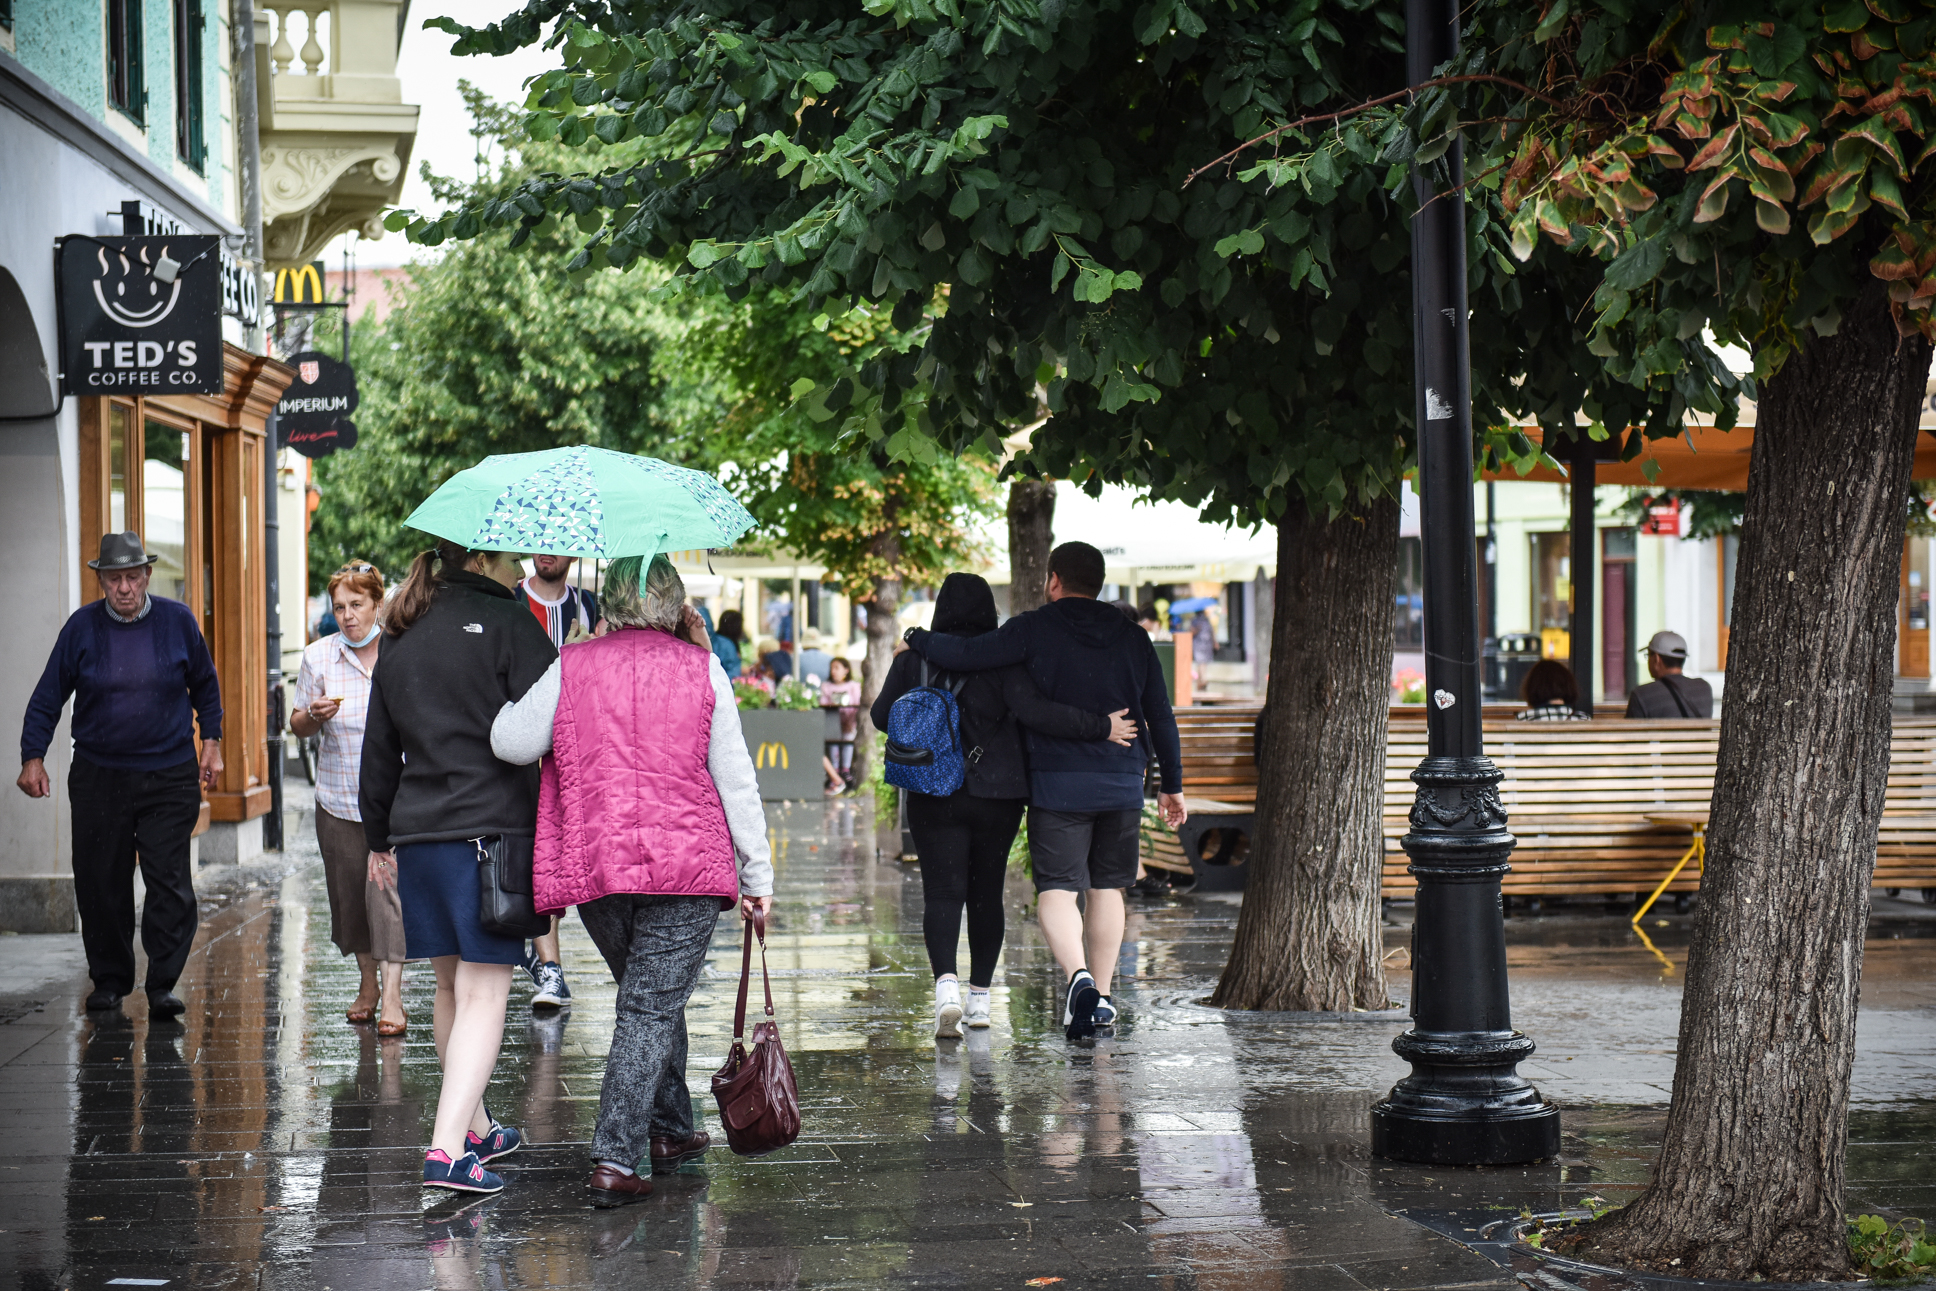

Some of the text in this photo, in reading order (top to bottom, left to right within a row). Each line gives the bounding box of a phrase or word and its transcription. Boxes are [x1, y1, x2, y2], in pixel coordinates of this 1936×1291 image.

[83, 340, 198, 368] TED'S
[88, 370, 202, 386] COFFEE CO.
[279, 396, 348, 414] IMPERIUM
[493, 1134, 504, 1149] N
[469, 1163, 484, 1181] N
